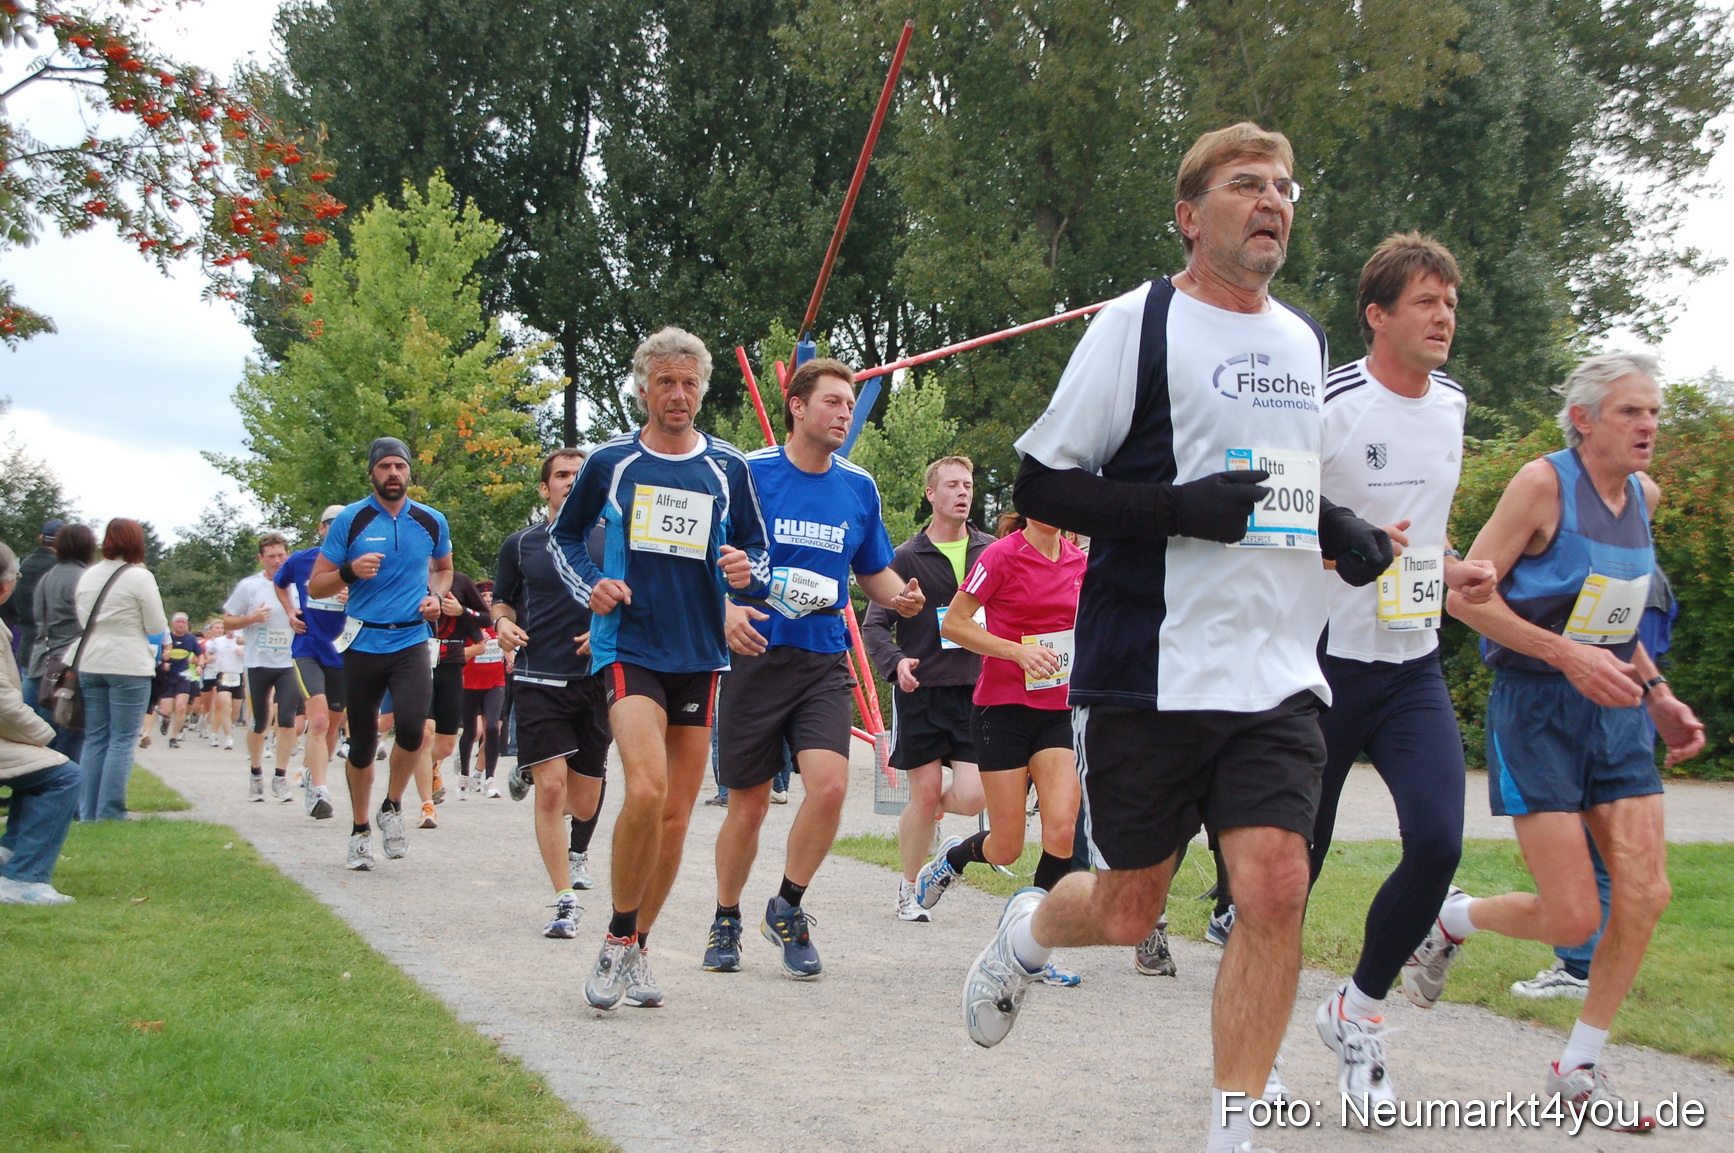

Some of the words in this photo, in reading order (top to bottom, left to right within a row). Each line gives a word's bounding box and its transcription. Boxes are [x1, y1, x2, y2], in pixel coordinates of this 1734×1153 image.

[1237, 372, 1316, 398] Fischer
[1260, 457, 1285, 475] Otto
[656, 493, 688, 510] Alfred
[1262, 486, 1315, 514] 2008
[636, 510, 641, 519] B
[661, 515, 698, 536] 537
[774, 518, 846, 545] HUBER
[790, 537, 841, 551] TECHNOLOGY
[1403, 556, 1437, 572] Thomas
[1382, 582, 1388, 593] B
[1412, 579, 1440, 603] 547
[789, 589, 828, 607] 2545
[1607, 607, 1631, 624] 60
[268, 637, 288, 645] 2173
